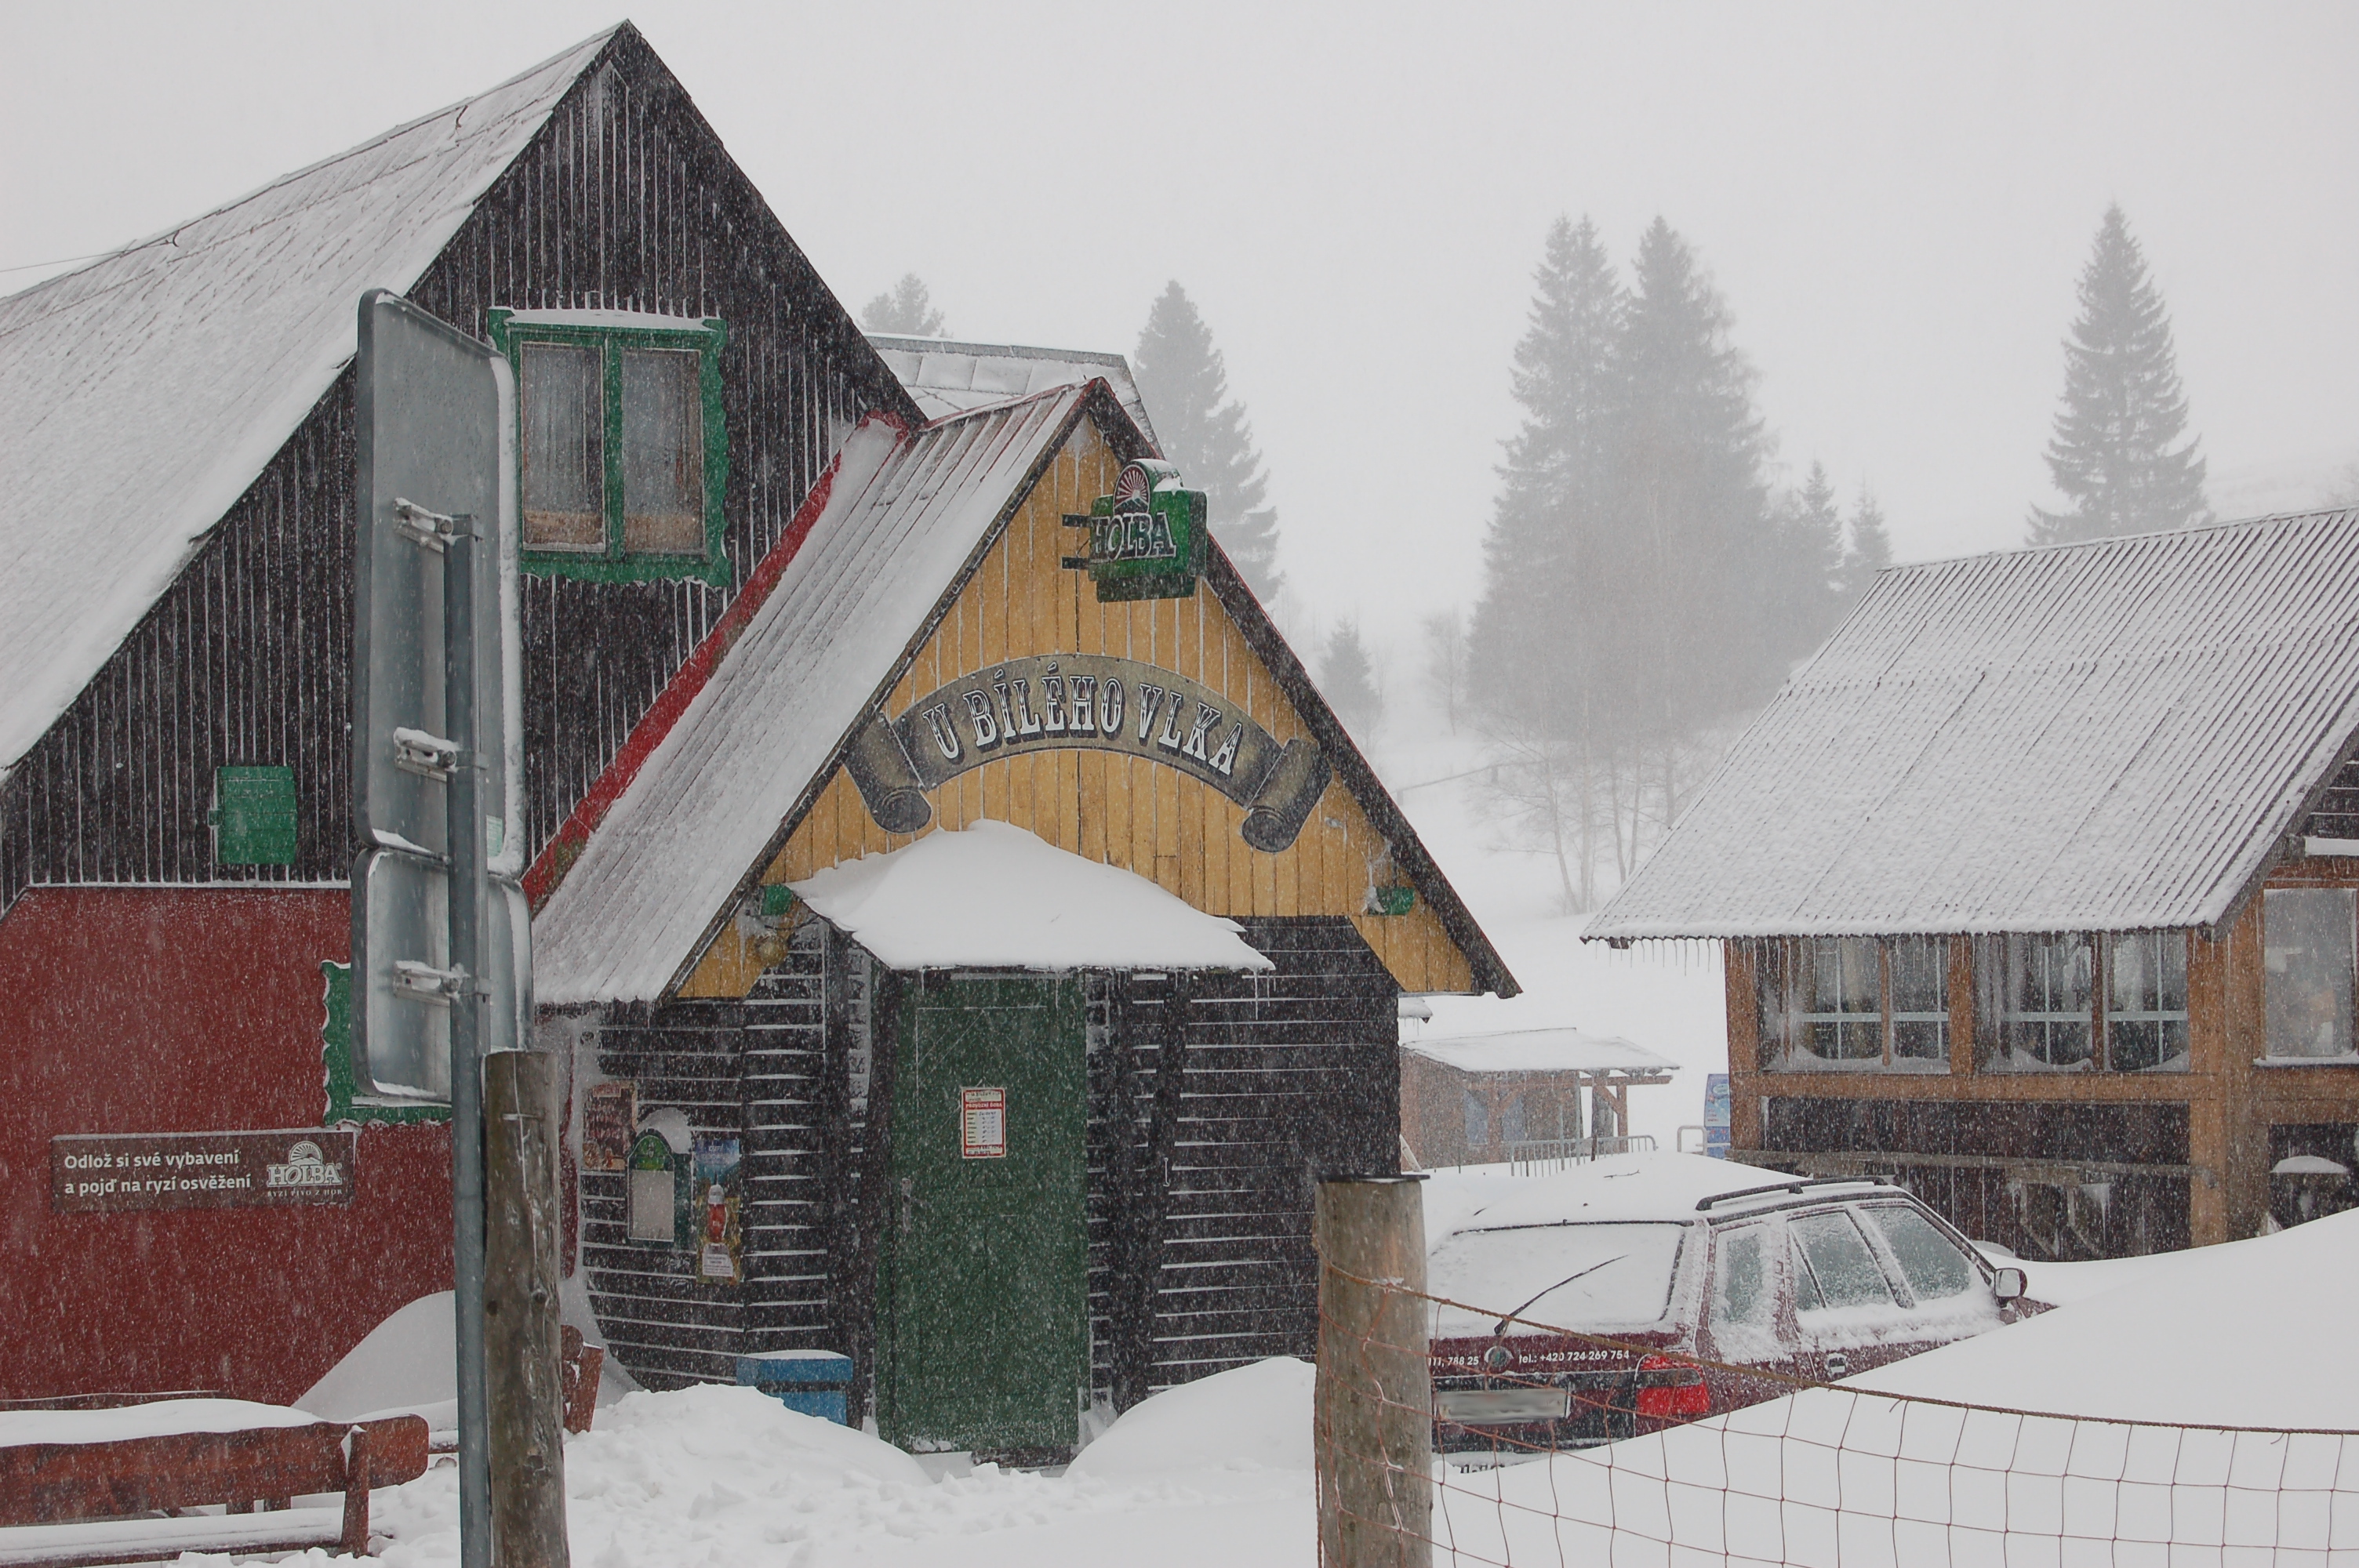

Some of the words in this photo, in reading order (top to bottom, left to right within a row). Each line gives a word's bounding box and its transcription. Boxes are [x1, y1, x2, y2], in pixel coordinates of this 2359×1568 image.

[1091, 510, 1176, 563] HOLBA
[922, 703, 964, 760] U
[963, 662, 1127, 751] BÍLÉHO
[1139, 683, 1244, 775] VLKA
[64, 1153, 112, 1169] Odlož
[116, 1152, 129, 1167] si
[134, 1152, 162, 1167] své
[165, 1149, 240, 1169] vybavení
[64, 1182, 75, 1194] a
[79, 1178, 118, 1197] pojď
[121, 1181, 141, 1192] na
[146, 1176, 177, 1195] ryzí
[180, 1173, 252, 1192] osvěžení
[267, 1162, 343, 1188] HOLBA
[1447, 1356, 1465, 1367] 788
[1467, 1356, 1480, 1366] 25
[1539, 1352, 1565, 1363] +420
[1567, 1351, 1586, 1361] 724
[1588, 1350, 1608, 1360] 269
[1610, 1349, 1630, 1360] 754
